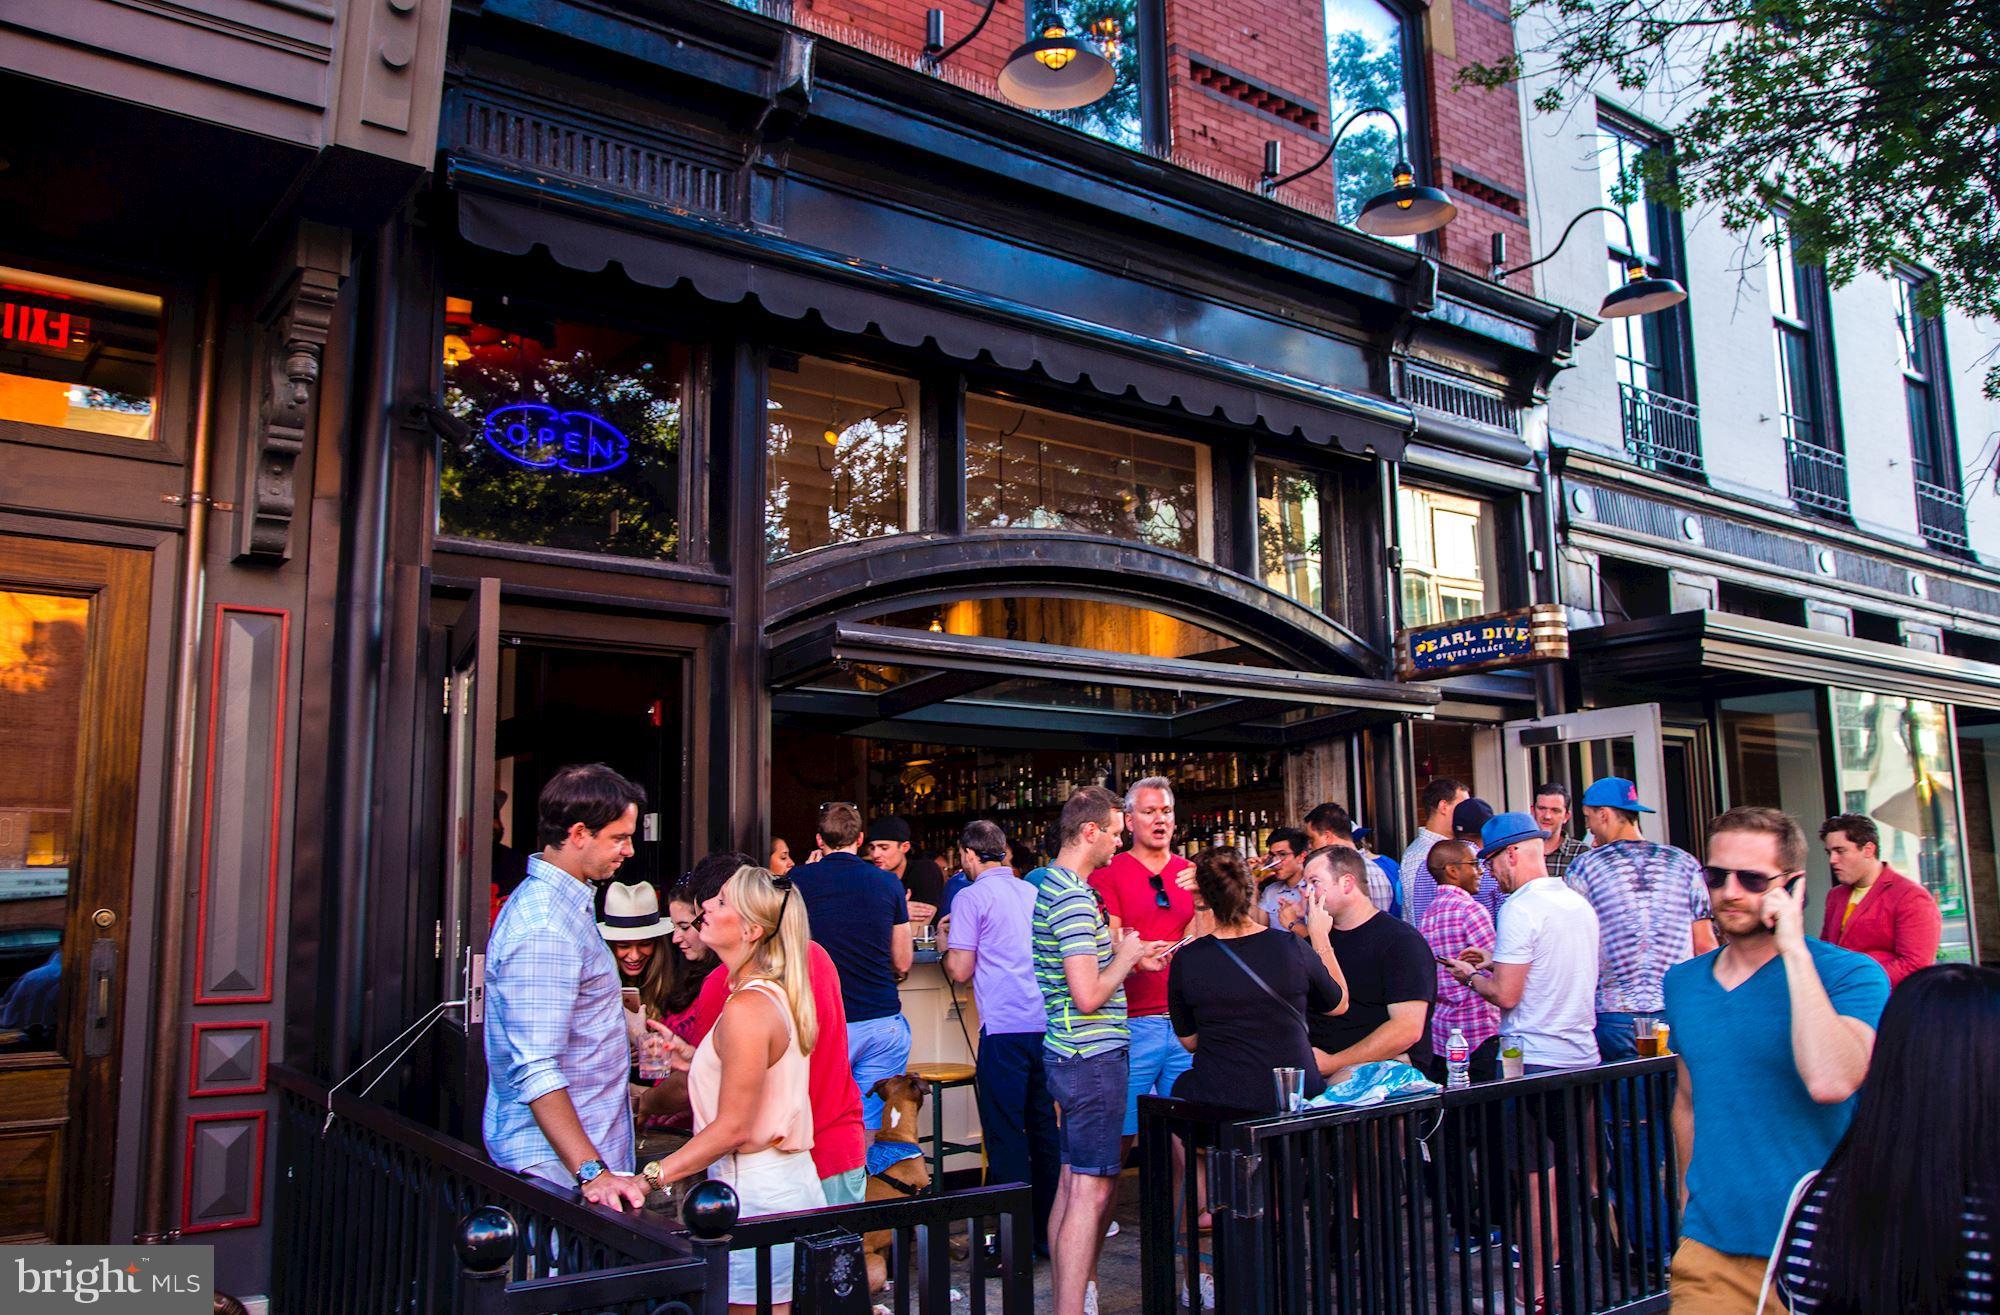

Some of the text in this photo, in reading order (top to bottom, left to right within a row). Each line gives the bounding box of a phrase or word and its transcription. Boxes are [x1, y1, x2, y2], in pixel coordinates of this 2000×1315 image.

[506, 423, 614, 459] OPEN
[1414, 627, 1529, 656] PEARL DIVE
[1435, 643, 1504, 660] OYSTER PALACE
